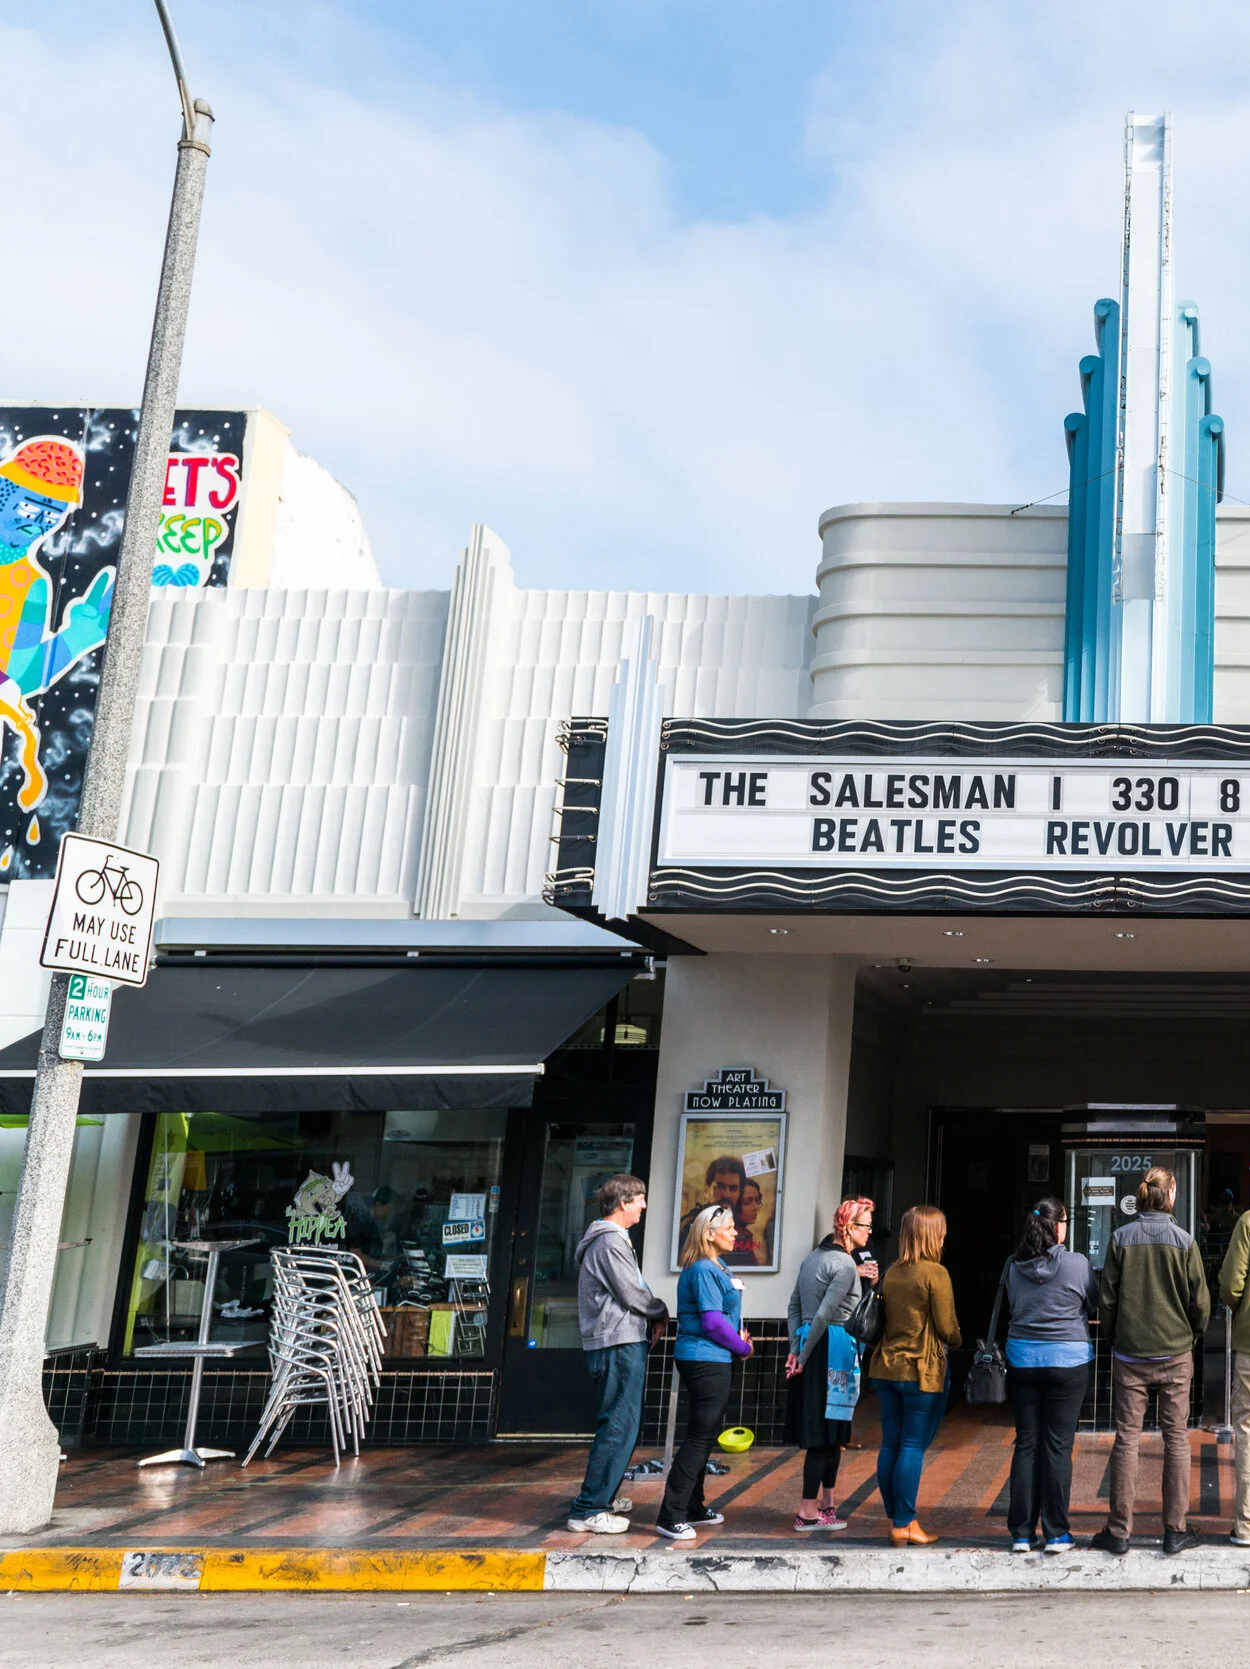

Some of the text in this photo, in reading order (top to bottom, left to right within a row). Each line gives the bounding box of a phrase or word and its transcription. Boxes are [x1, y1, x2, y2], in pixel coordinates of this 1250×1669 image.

[162, 456, 237, 509] ET'S
[699, 771, 768, 806] THE
[809, 771, 1016, 809] SALESMAN
[1112, 776, 1179, 812] 330
[1220, 778, 1240, 813] 8
[811, 817, 981, 854] BEATLES
[1045, 821, 1232, 857] REVOLVER
[72, 912, 137, 944] MAY USE
[54, 938, 140, 973] FULL LANE
[71, 978, 110, 999] 2 HOUR
[67, 1004, 107, 1024] PARKING
[726, 1072, 747, 1082] ART
[711, 1084, 760, 1094] THEATER
[692, 1096, 777, 1108] NOW PLAYING
[1111, 1155, 1152, 1171] 2025
[444, 1223, 470, 1237] CLOSED
